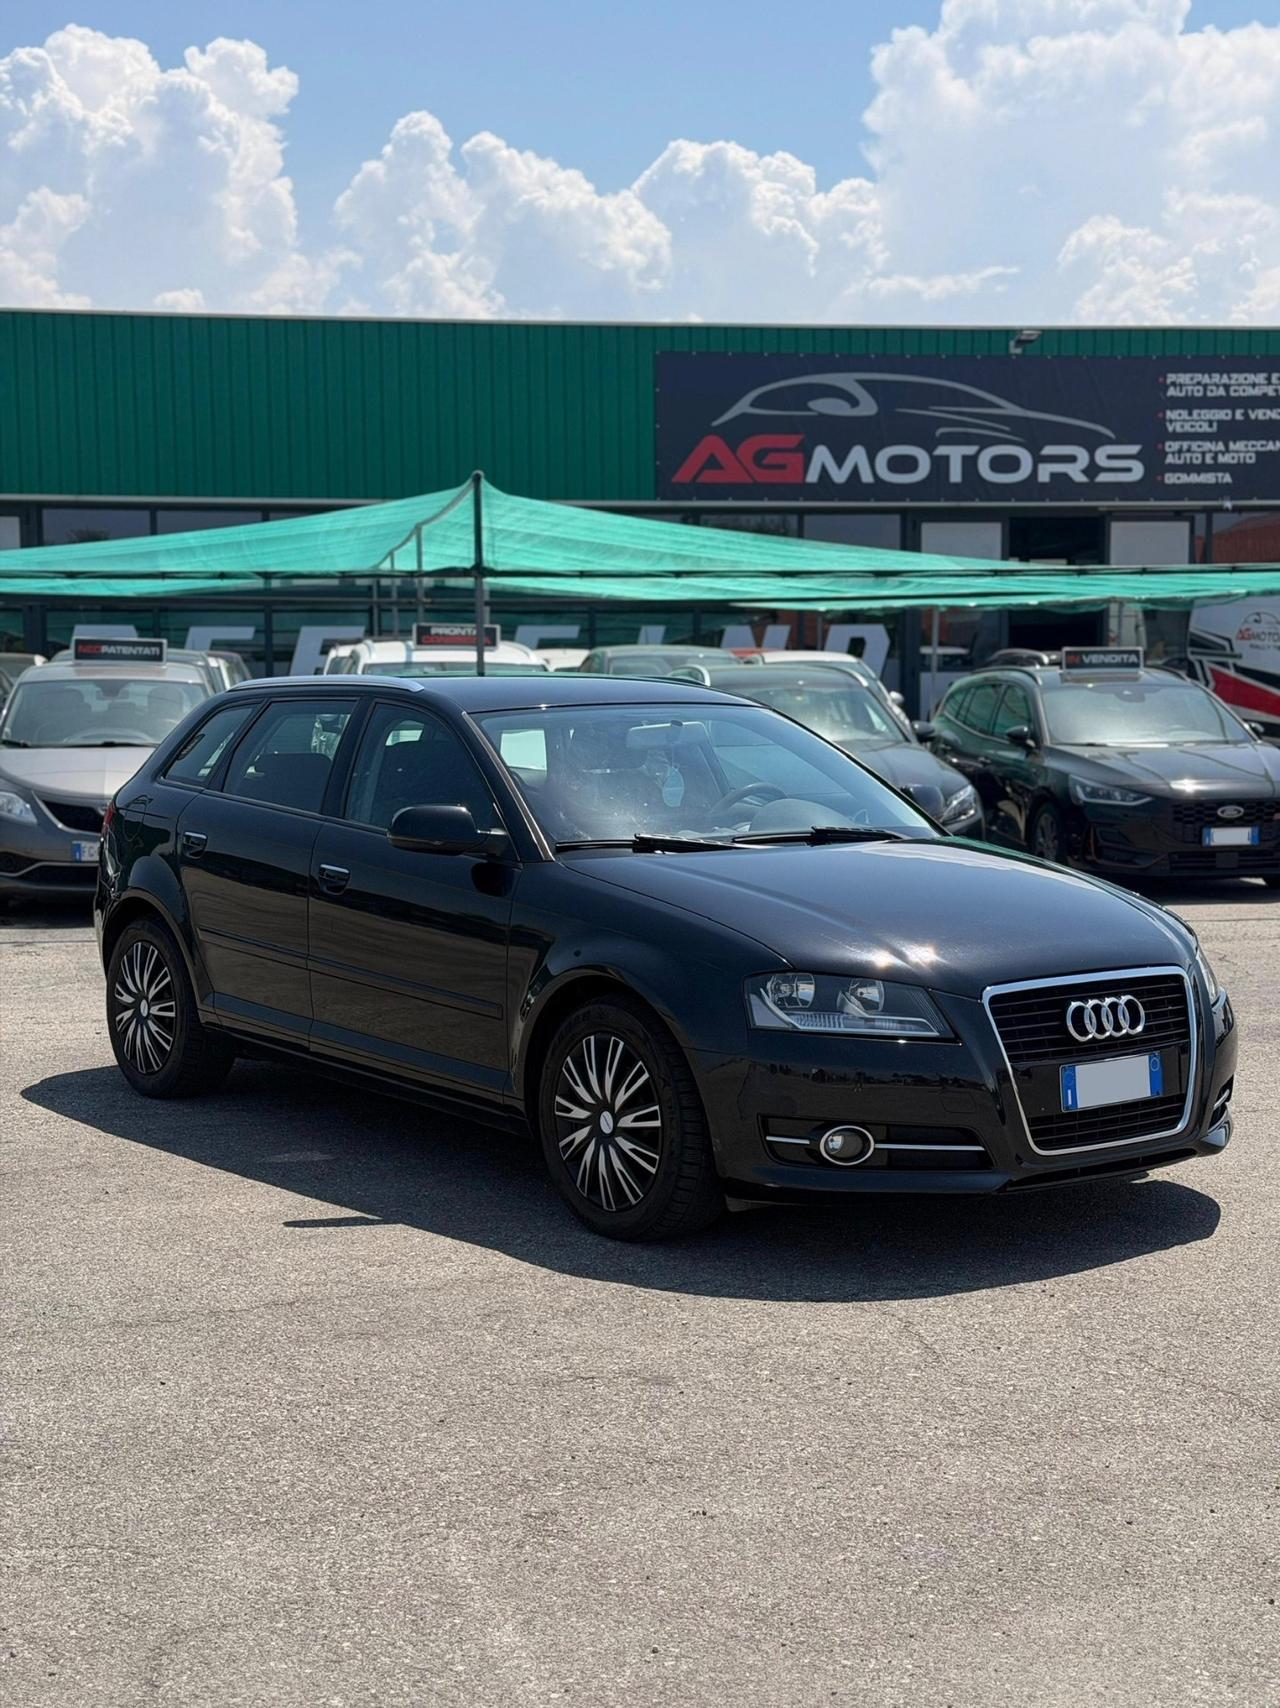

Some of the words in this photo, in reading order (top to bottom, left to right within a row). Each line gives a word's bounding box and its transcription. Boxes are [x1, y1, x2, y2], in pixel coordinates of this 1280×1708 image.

[1166, 373, 1268, 385] PREPARAZIONE
[1166, 385, 1204, 397] AUTO
[1206, 385, 1226, 397] DA
[1165, 409, 1232, 420] NOLEGGIO
[1234, 409, 1245, 420] E
[1165, 421, 1218, 433] VEICOLI
[1164, 441, 1226, 452] OFFICINA
[1164, 453, 1203, 464] AUTO
[1204, 453, 1214, 464] E
[1217, 452, 1256, 464] MOTO
[1163, 472, 1232, 484] GOMMISTA
[1081, 653, 1139, 664] VENDITA
